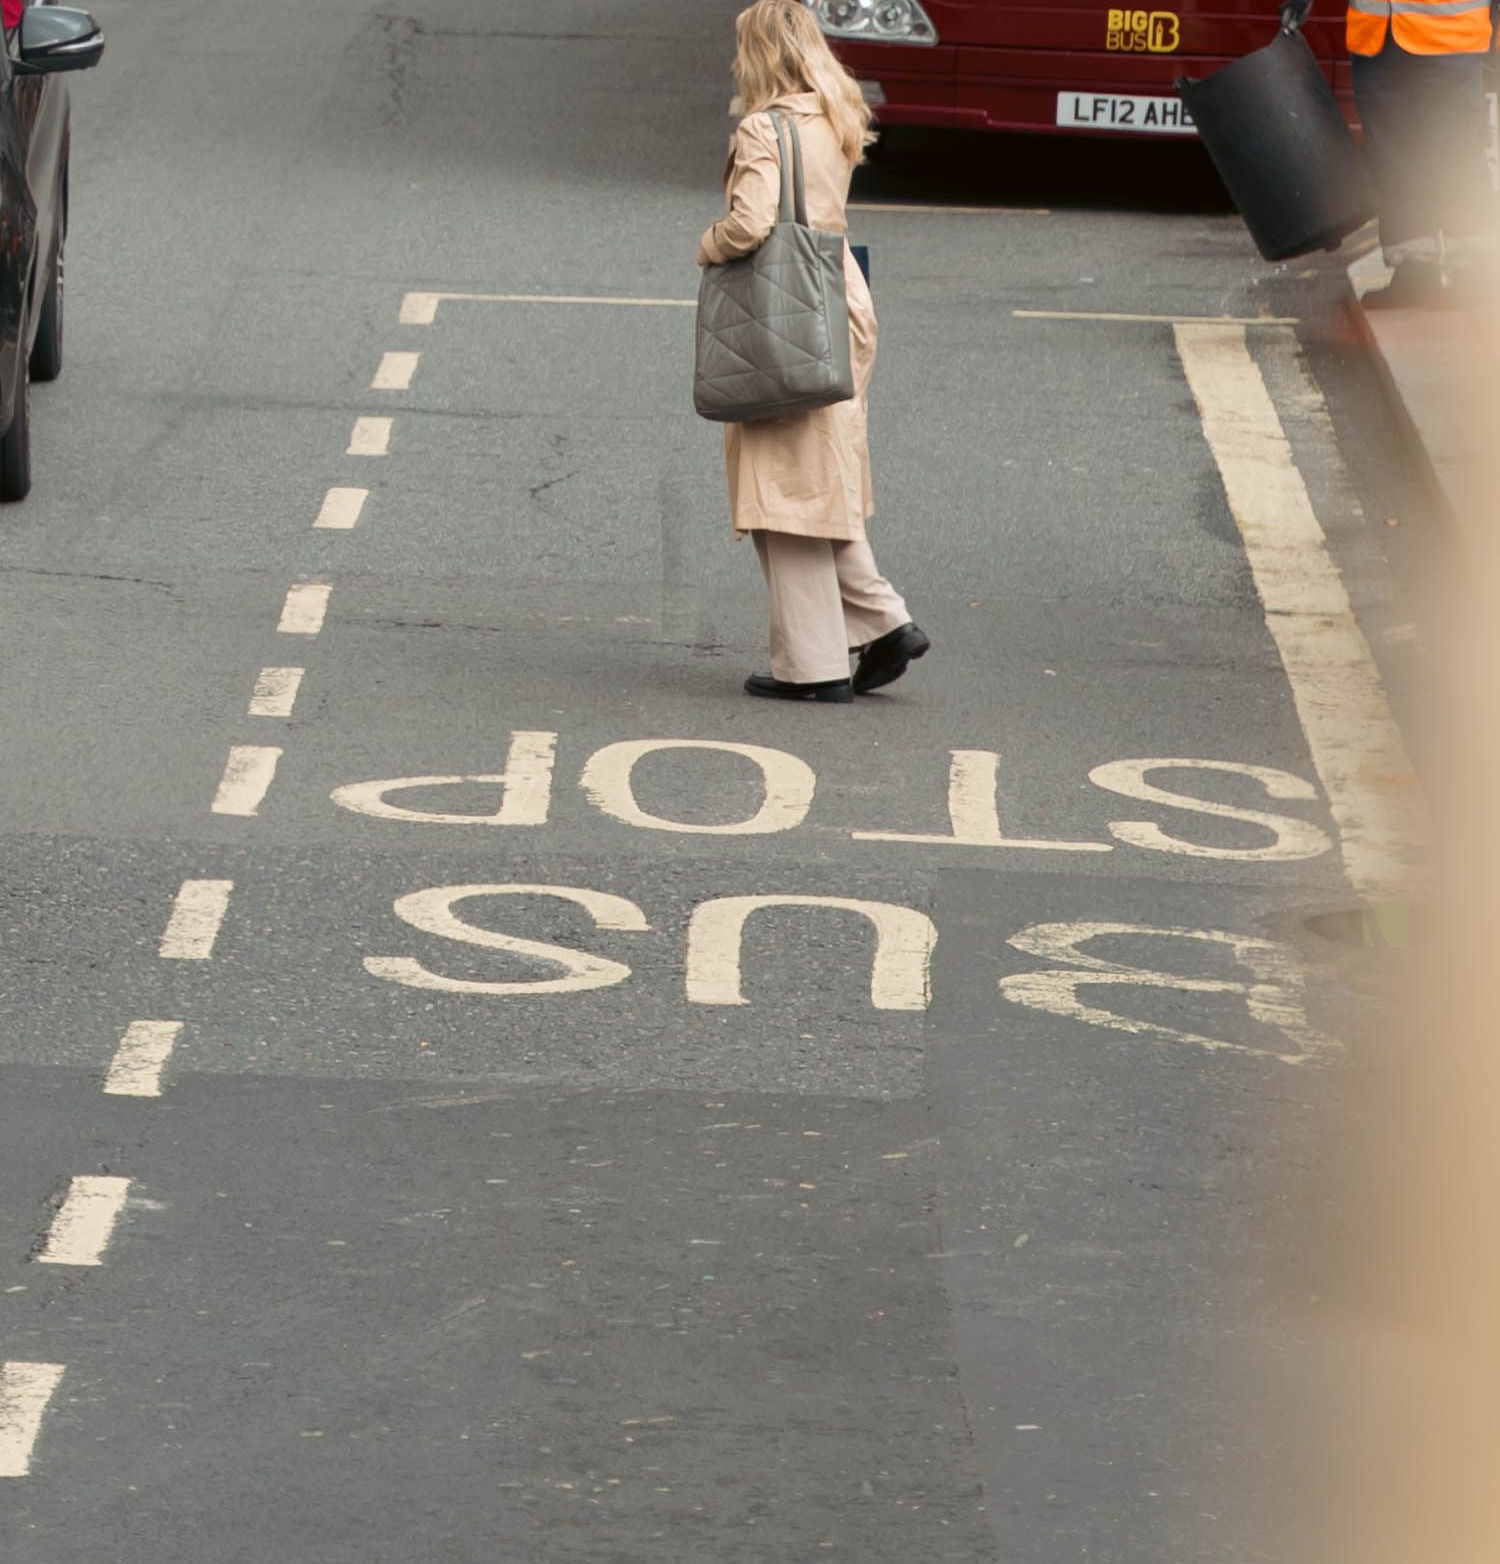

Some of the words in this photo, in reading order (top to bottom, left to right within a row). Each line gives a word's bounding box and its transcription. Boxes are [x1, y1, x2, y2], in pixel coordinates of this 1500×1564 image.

[1107, 9, 1148, 32] BIG
[1106, 31, 1147, 51] BUS
[1073, 96, 1135, 125] LF12
[331, 731, 1334, 862] STOP
[362, 883, 1343, 1066] BUS
